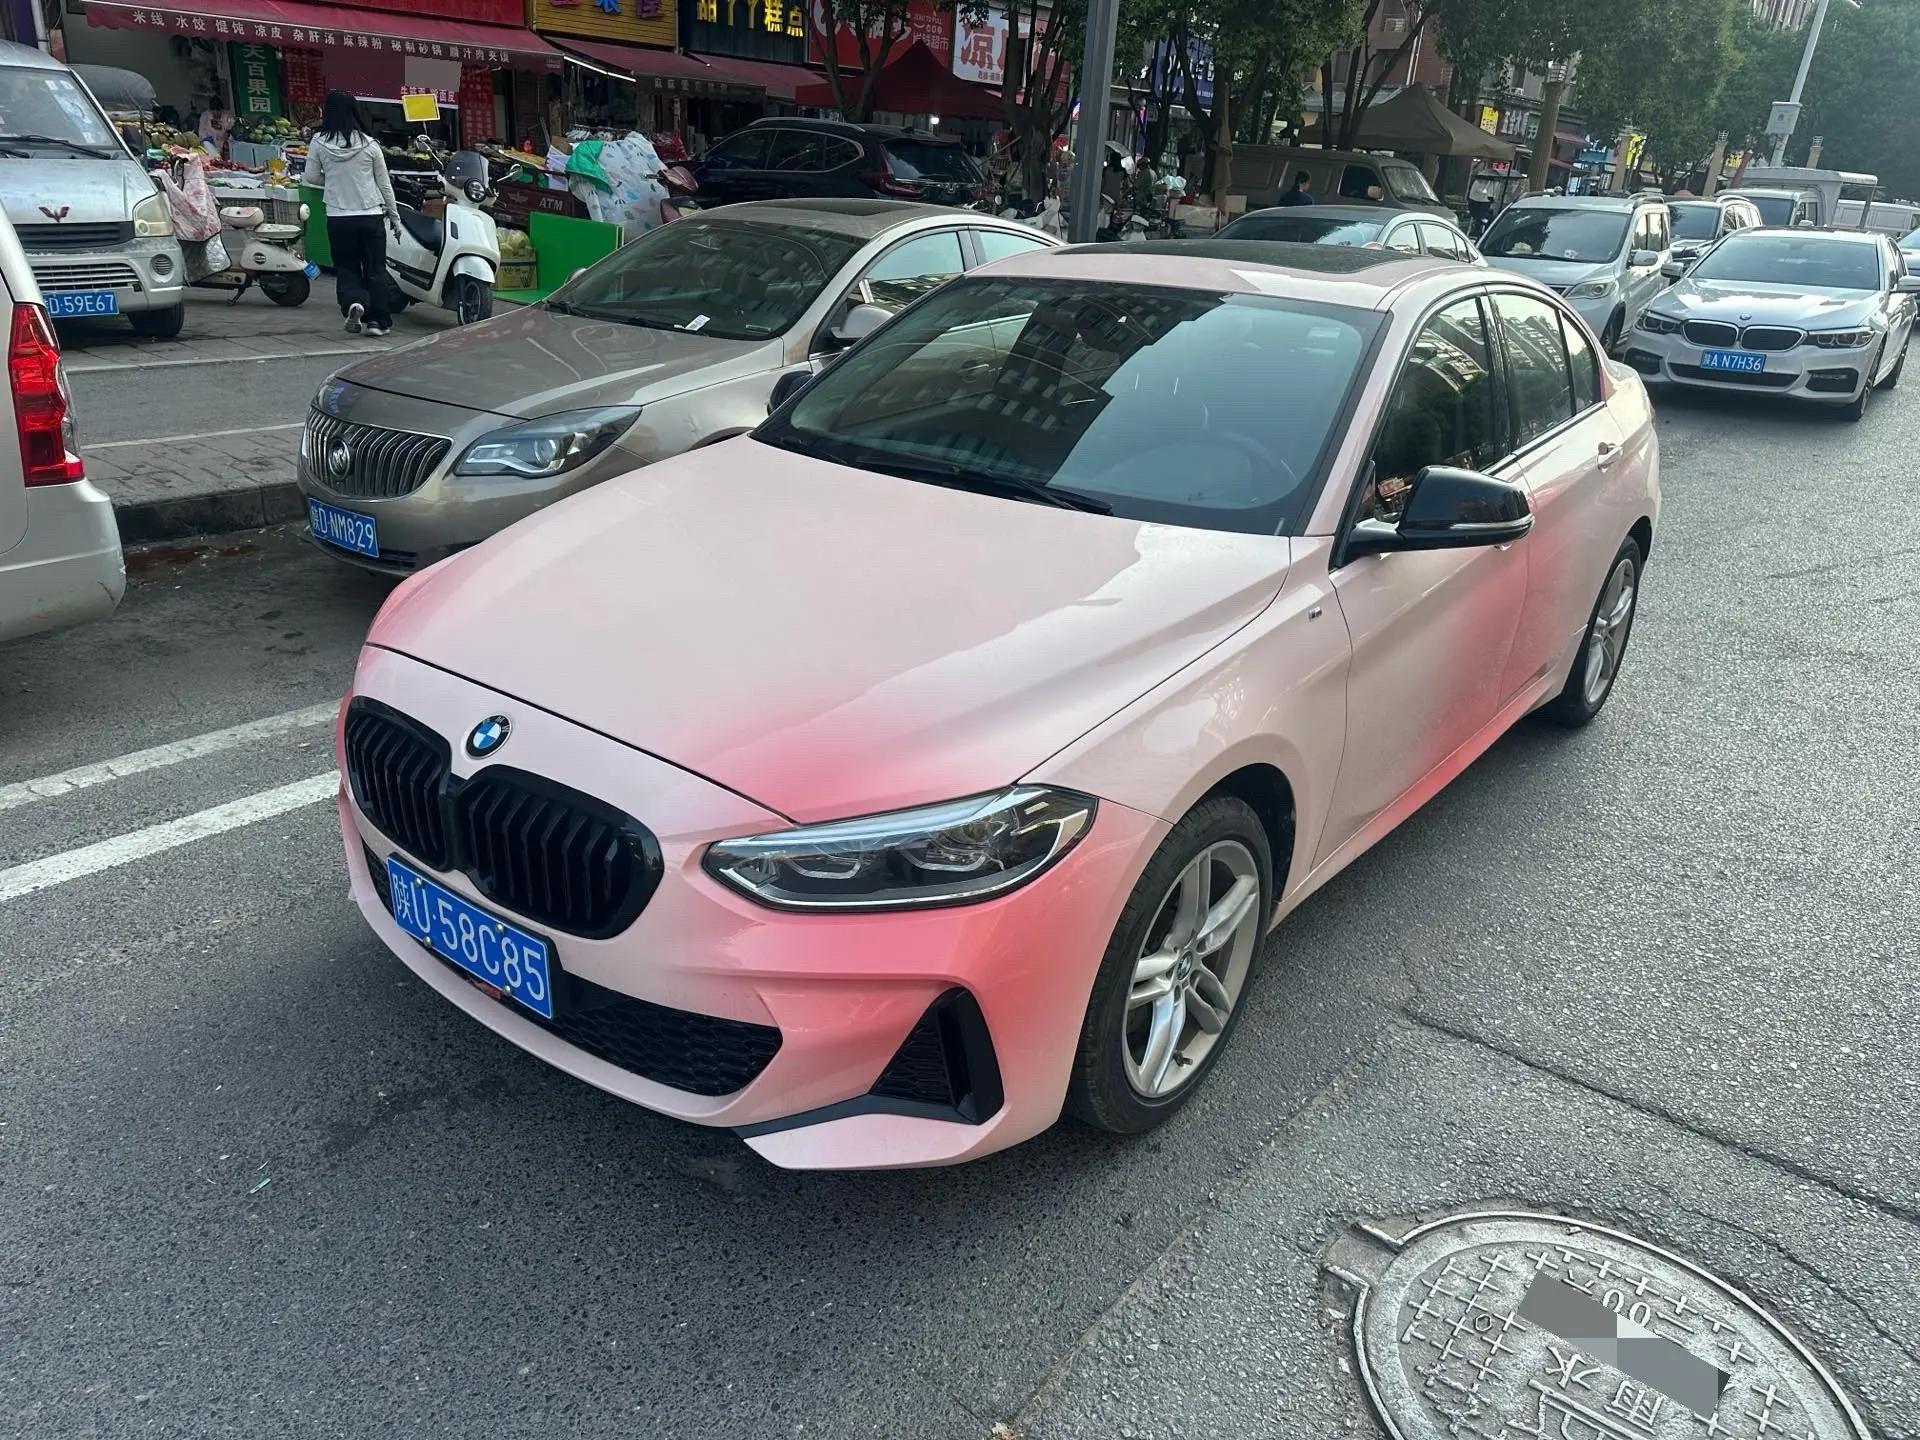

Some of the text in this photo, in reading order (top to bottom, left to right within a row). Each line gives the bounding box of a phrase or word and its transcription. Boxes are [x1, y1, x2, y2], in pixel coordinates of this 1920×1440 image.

[132, 10, 165, 26] 米线
[176, 15, 206, 31] 水饺
[215, 20, 245, 35] 馄饨
[254, 23, 283, 40] 凉皮
[292, 28, 335, 46] 杂肝汤
[343, 35, 382, 50] 麻辣粉
[391, 40, 442, 56] 秘制砂锅
[539, 197, 564, 211] ATM
